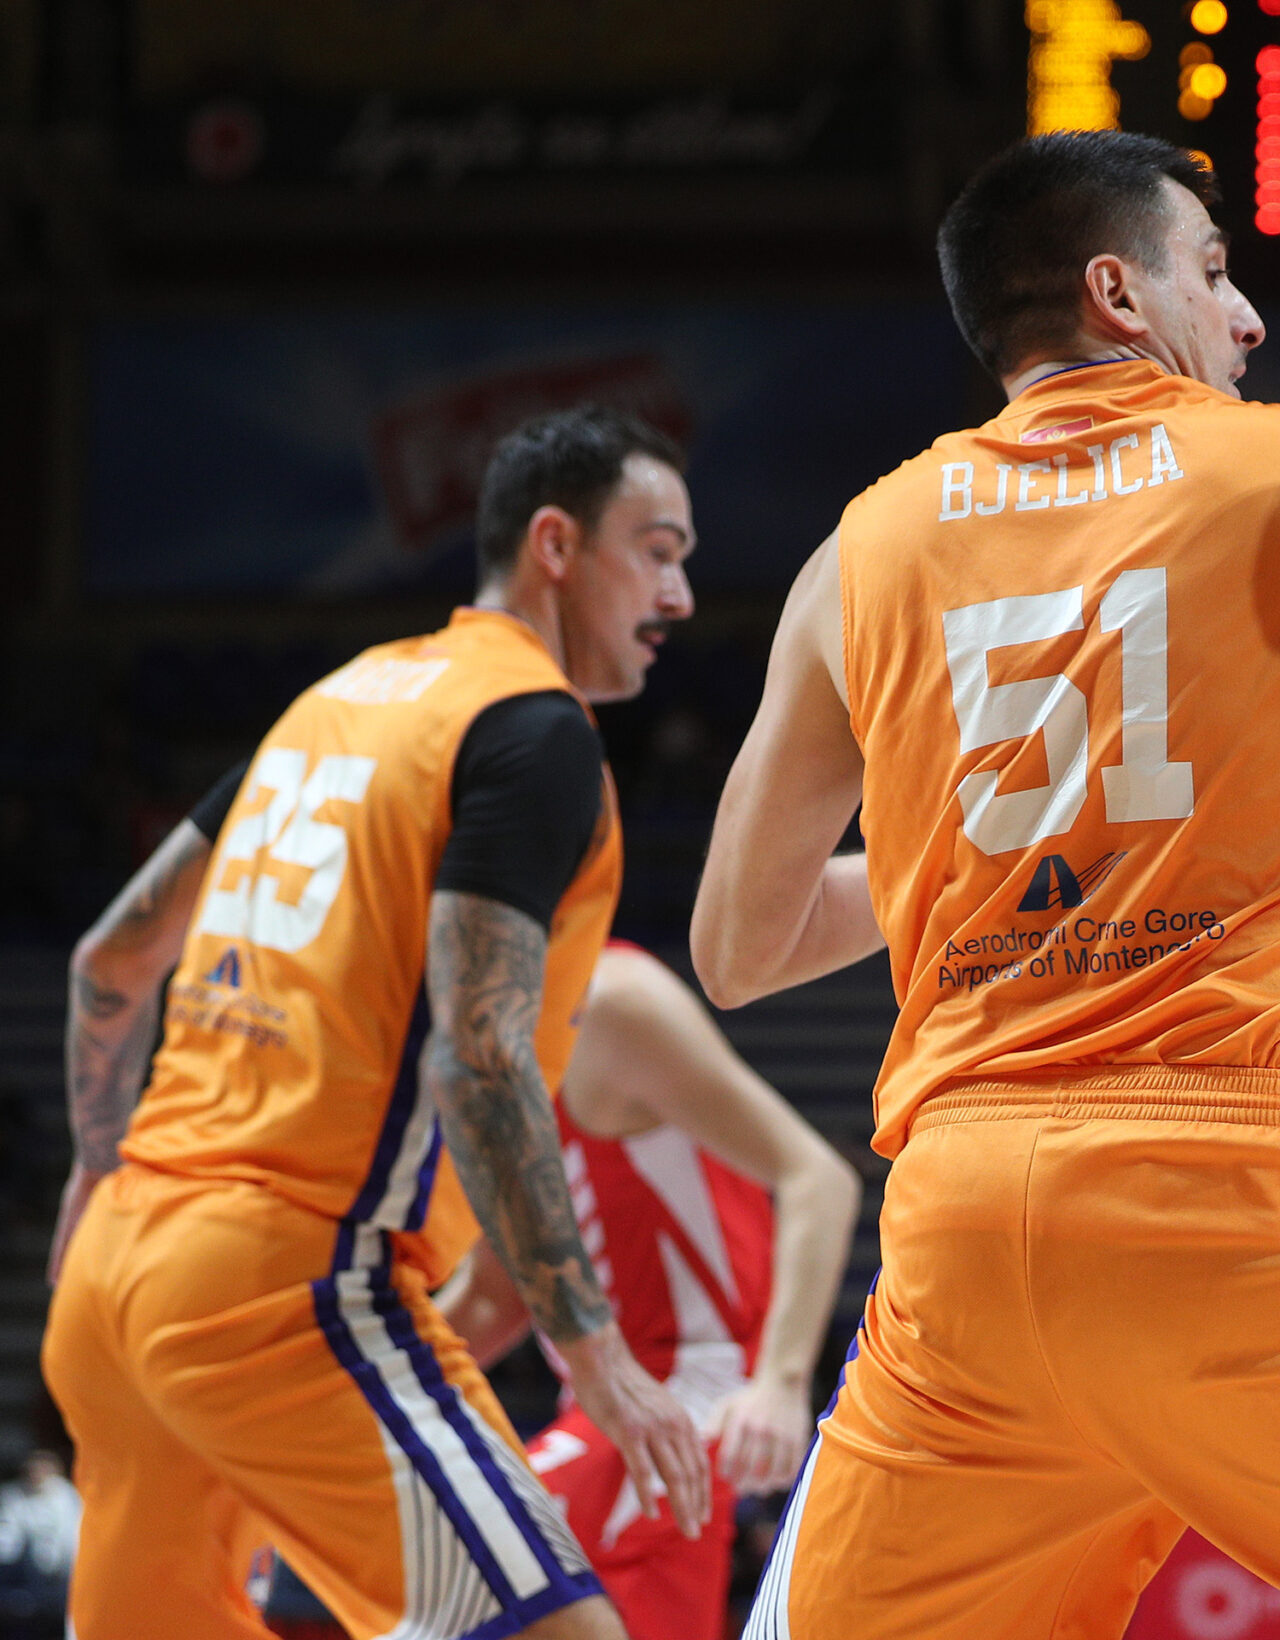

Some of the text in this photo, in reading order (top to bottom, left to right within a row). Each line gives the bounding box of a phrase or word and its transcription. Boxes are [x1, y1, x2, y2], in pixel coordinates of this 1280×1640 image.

[939, 424, 1184, 522] BJELICA
[942, 567, 1194, 856] 51
[199, 746, 378, 954] 25
[945, 908, 1217, 961] Aerodromi Crne Gore
[1029, 950, 1054, 978] of
[1063, 923, 1225, 975] Monteneo
